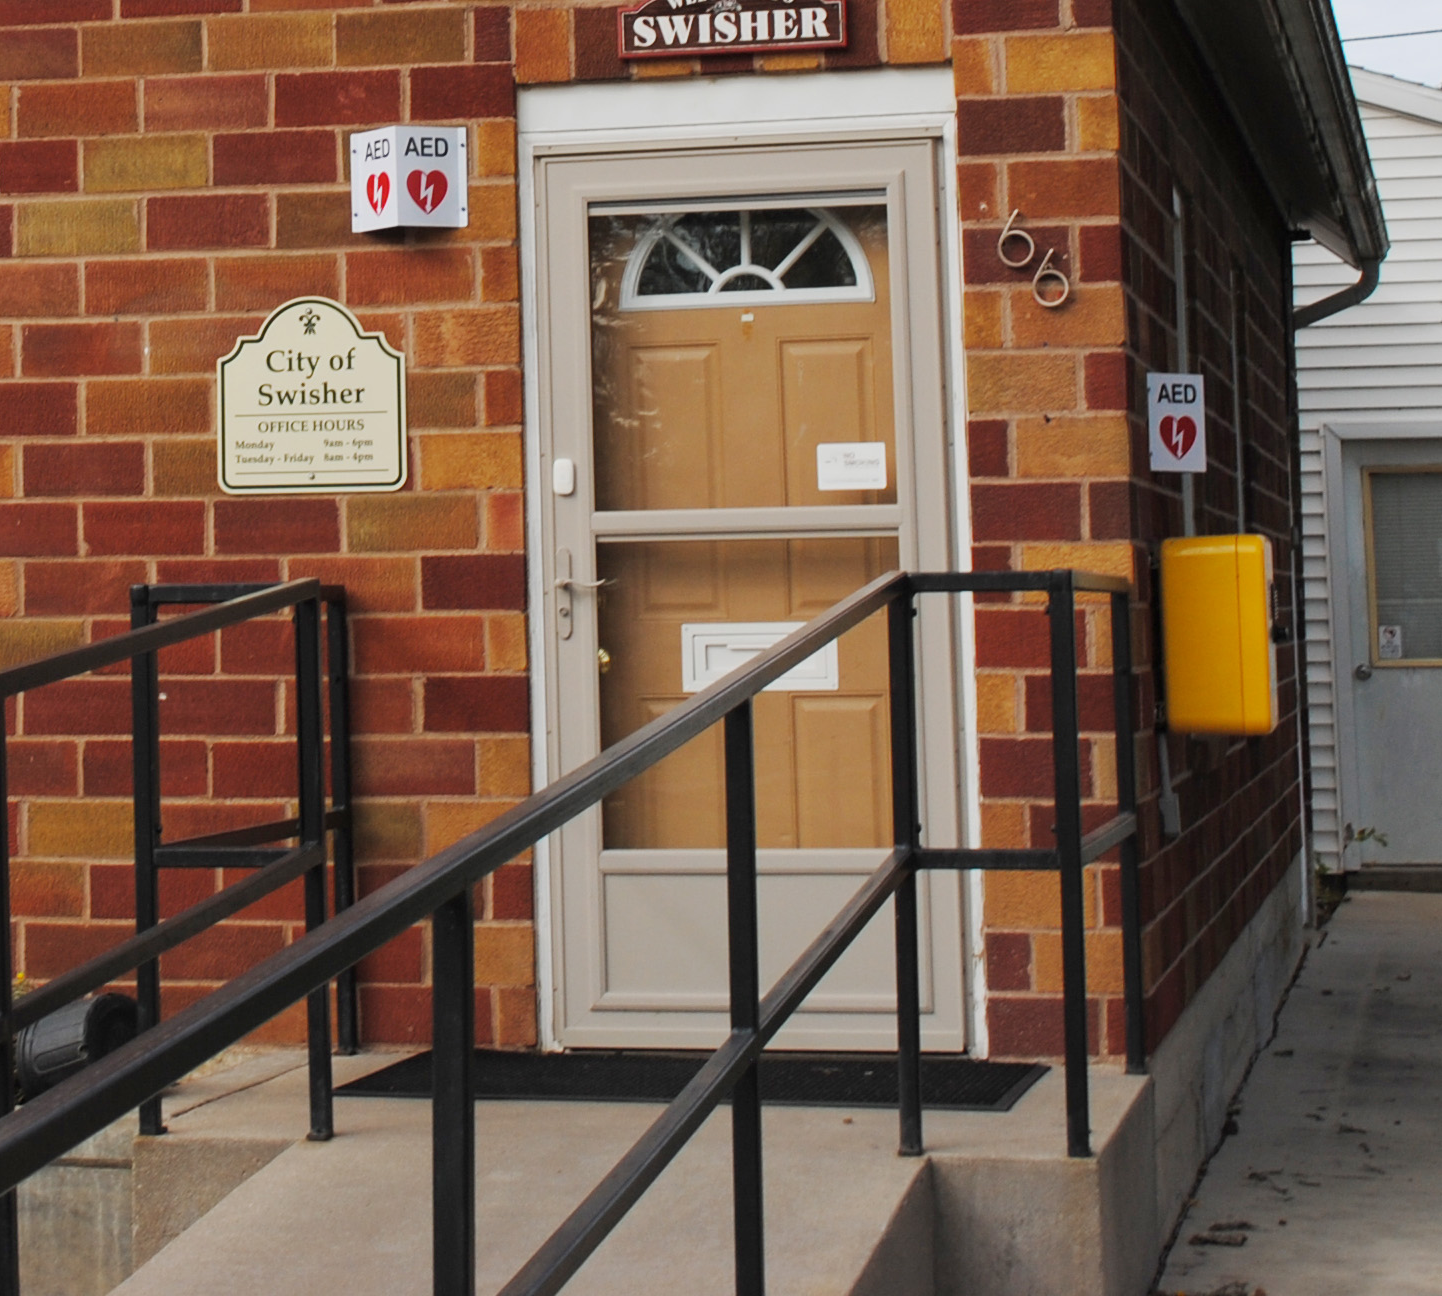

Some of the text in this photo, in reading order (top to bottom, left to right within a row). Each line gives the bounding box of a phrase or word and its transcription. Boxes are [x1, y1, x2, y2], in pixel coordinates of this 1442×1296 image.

[632, 7, 830, 47] SWISHER
[364, 138, 390, 162] AED
[404, 137, 449, 157] AED
[266, 347, 356, 379] City of
[258, 382, 365, 406] Swisher
[1158, 384, 1197, 404] AED
[258, 419, 365, 432] OFFICE HOURS
[235, 440, 275, 451] Monday
[323, 438, 344, 448] 9am
[352, 437, 373, 449] 6pm
[235, 455, 275, 466] Tuesday
[284, 453, 314, 465] Friday
[352, 452, 373, 463] 4pm
